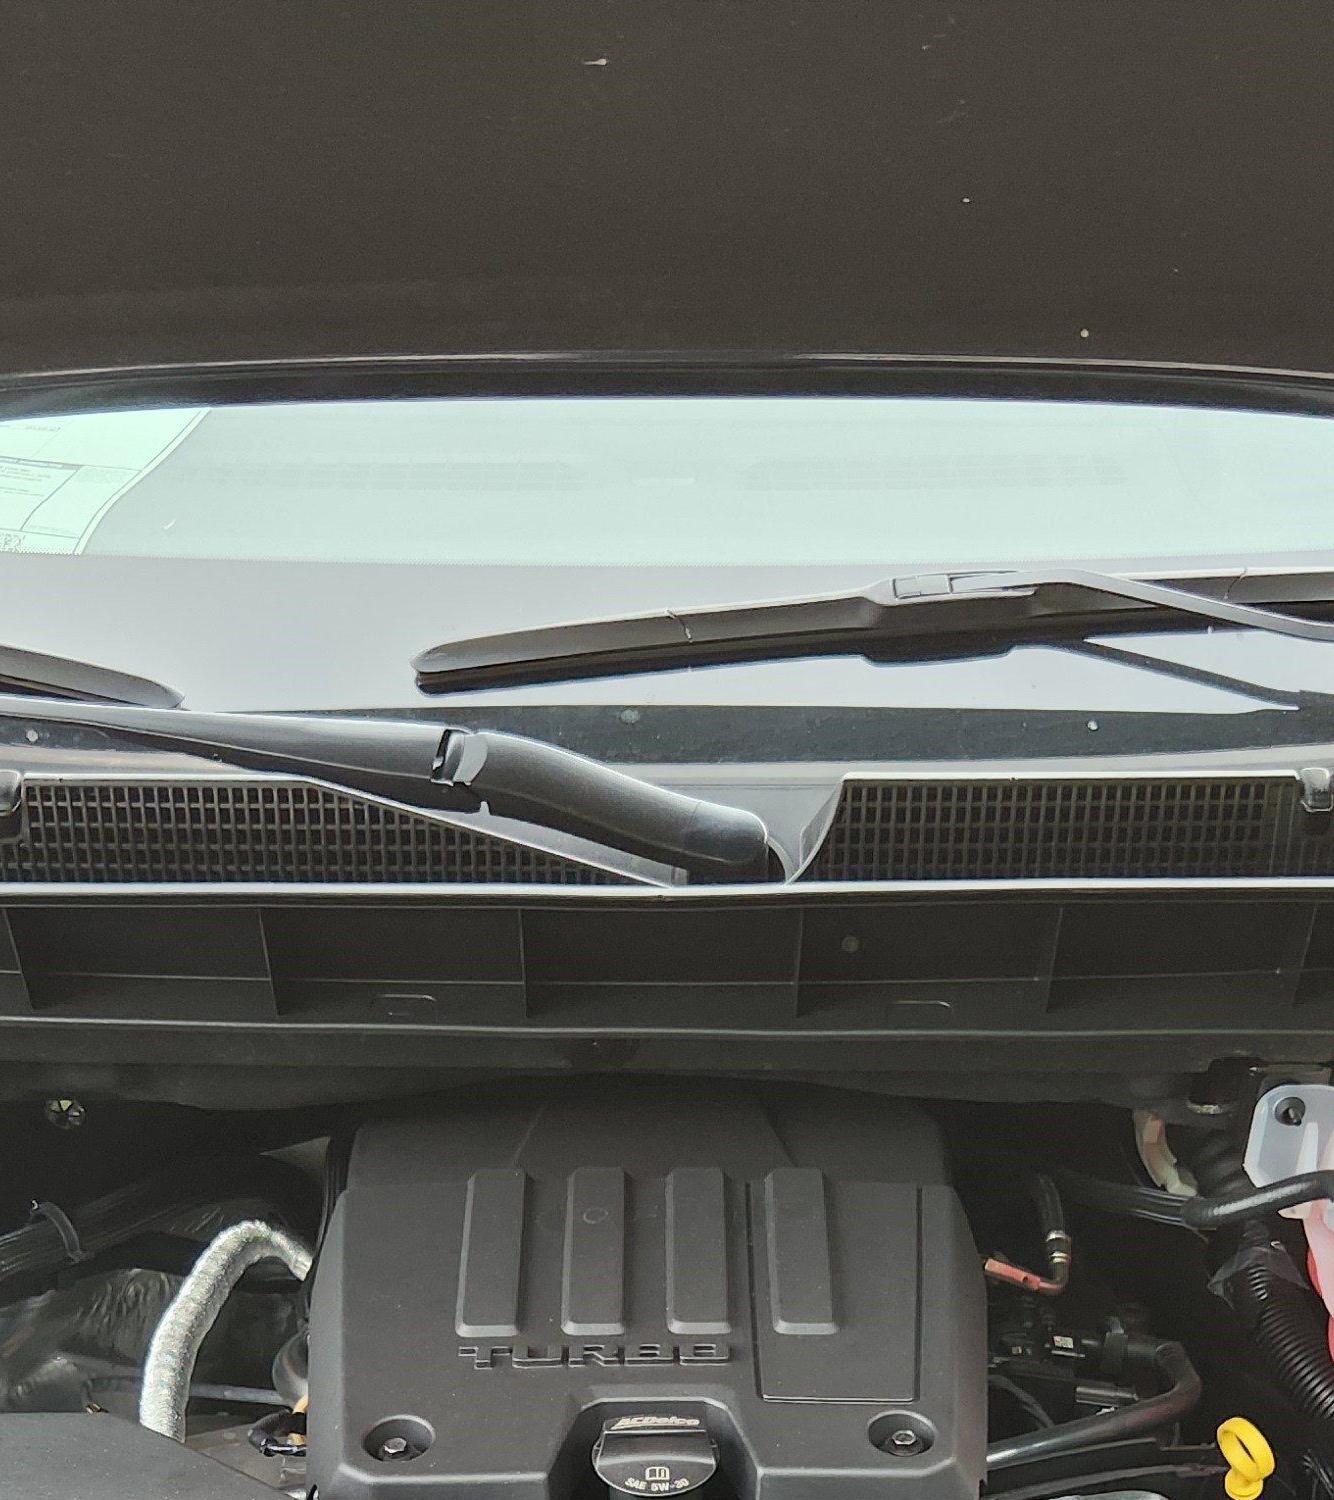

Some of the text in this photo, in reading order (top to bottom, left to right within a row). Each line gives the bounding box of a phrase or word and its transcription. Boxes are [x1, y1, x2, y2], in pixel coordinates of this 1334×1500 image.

[610, 1416, 700, 1430] ACDelco
[625, 1477, 689, 1492] SAE 5W-30
